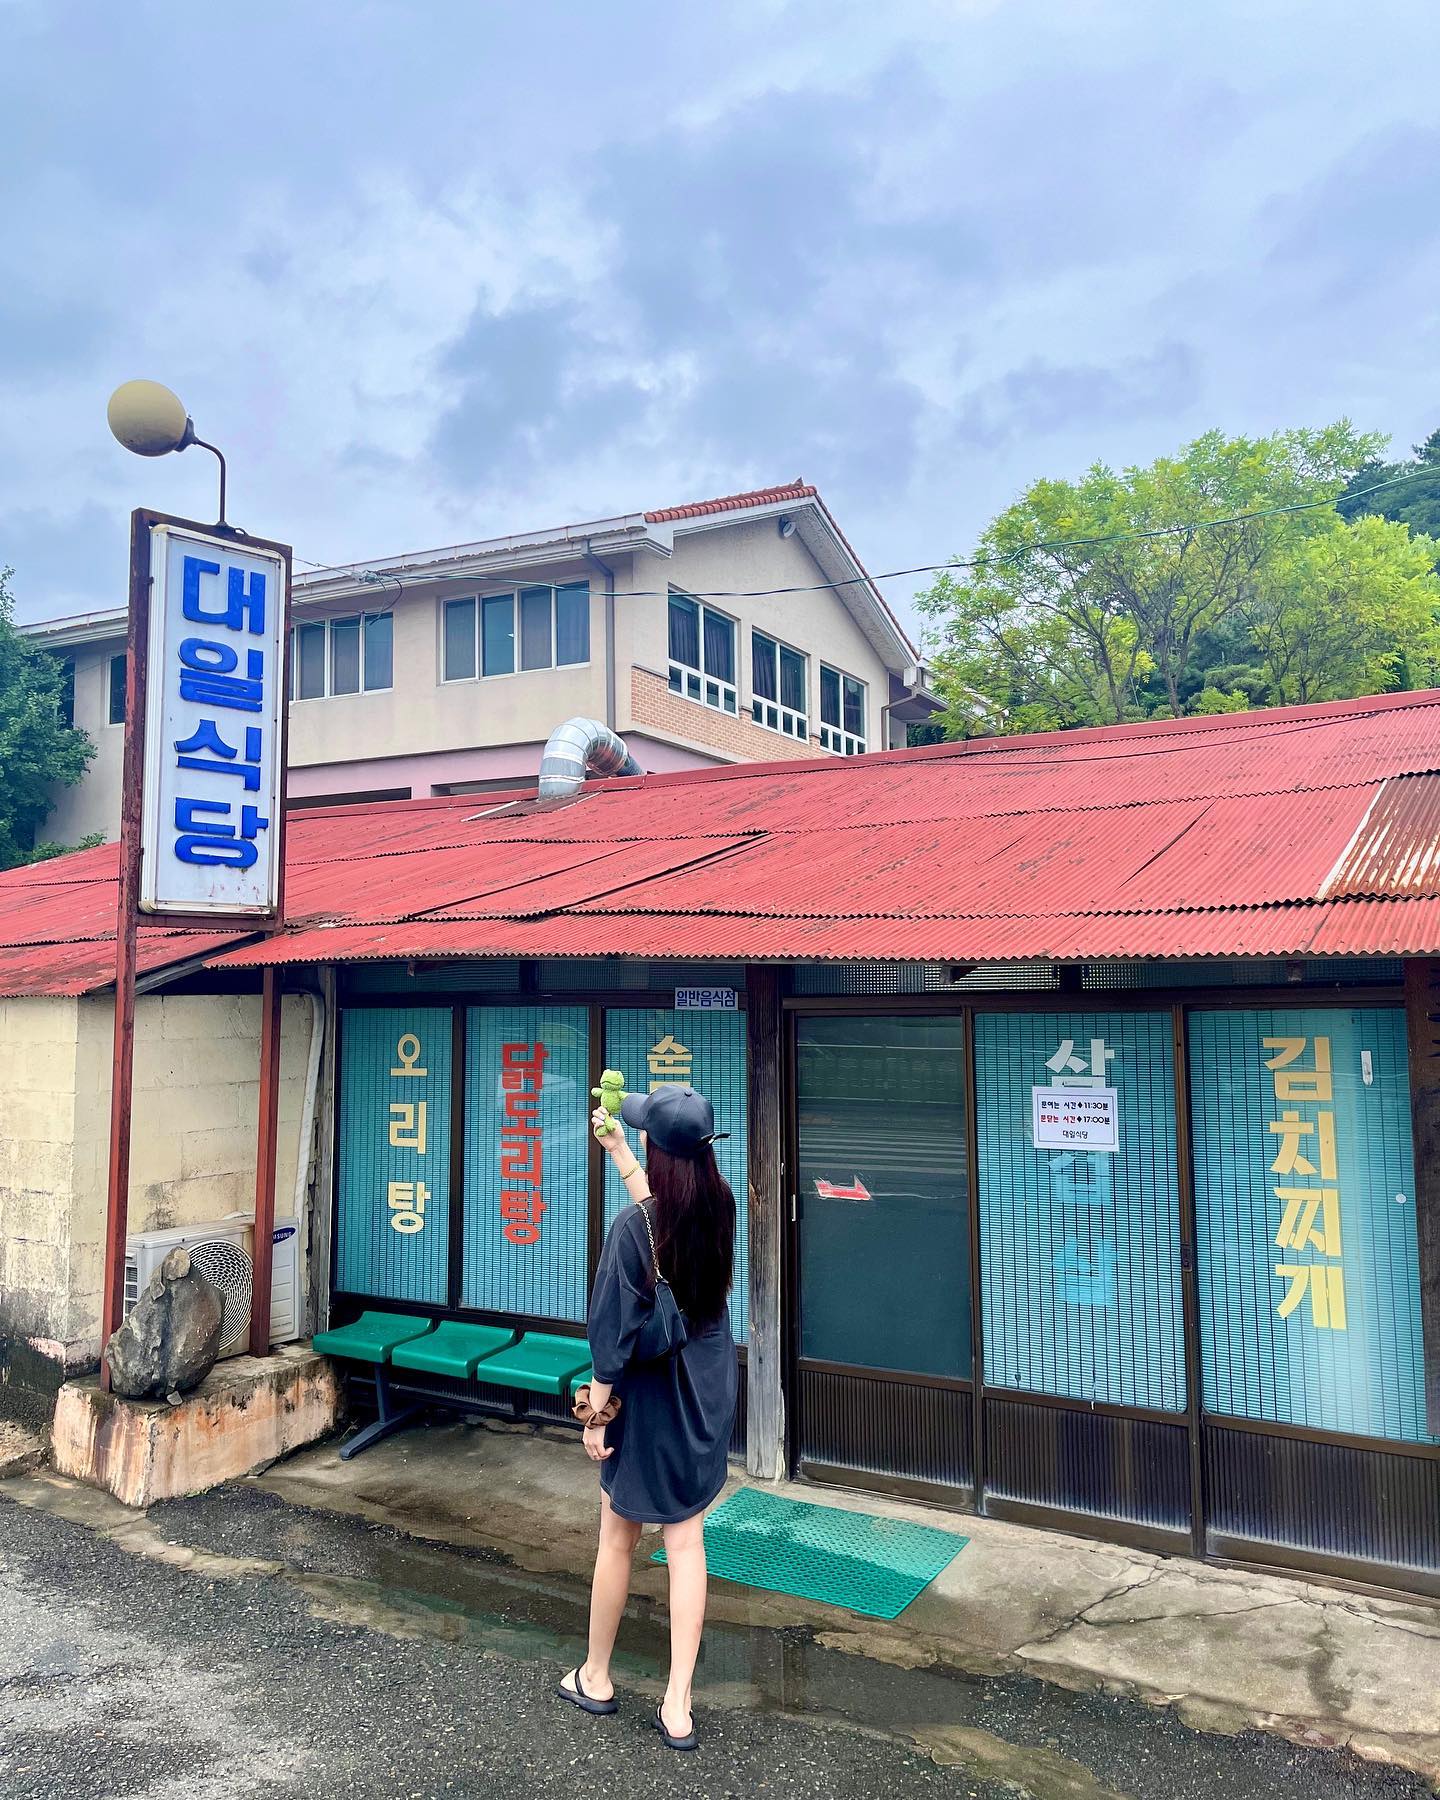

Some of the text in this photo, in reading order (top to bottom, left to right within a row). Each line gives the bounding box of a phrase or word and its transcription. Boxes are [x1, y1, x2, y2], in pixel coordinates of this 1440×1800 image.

[173, 555, 269, 869] 대일식당
[647, 1035, 692, 1095] 순
[676, 990, 736, 1008] 일반음식점
[388, 1033, 432, 1234] 오리탕
[500, 1042, 549, 1245] 닭도리탕
[1062, 1130, 1088, 1139] 대일식당
[1263, 1036, 1347, 1330] 김치찌개
